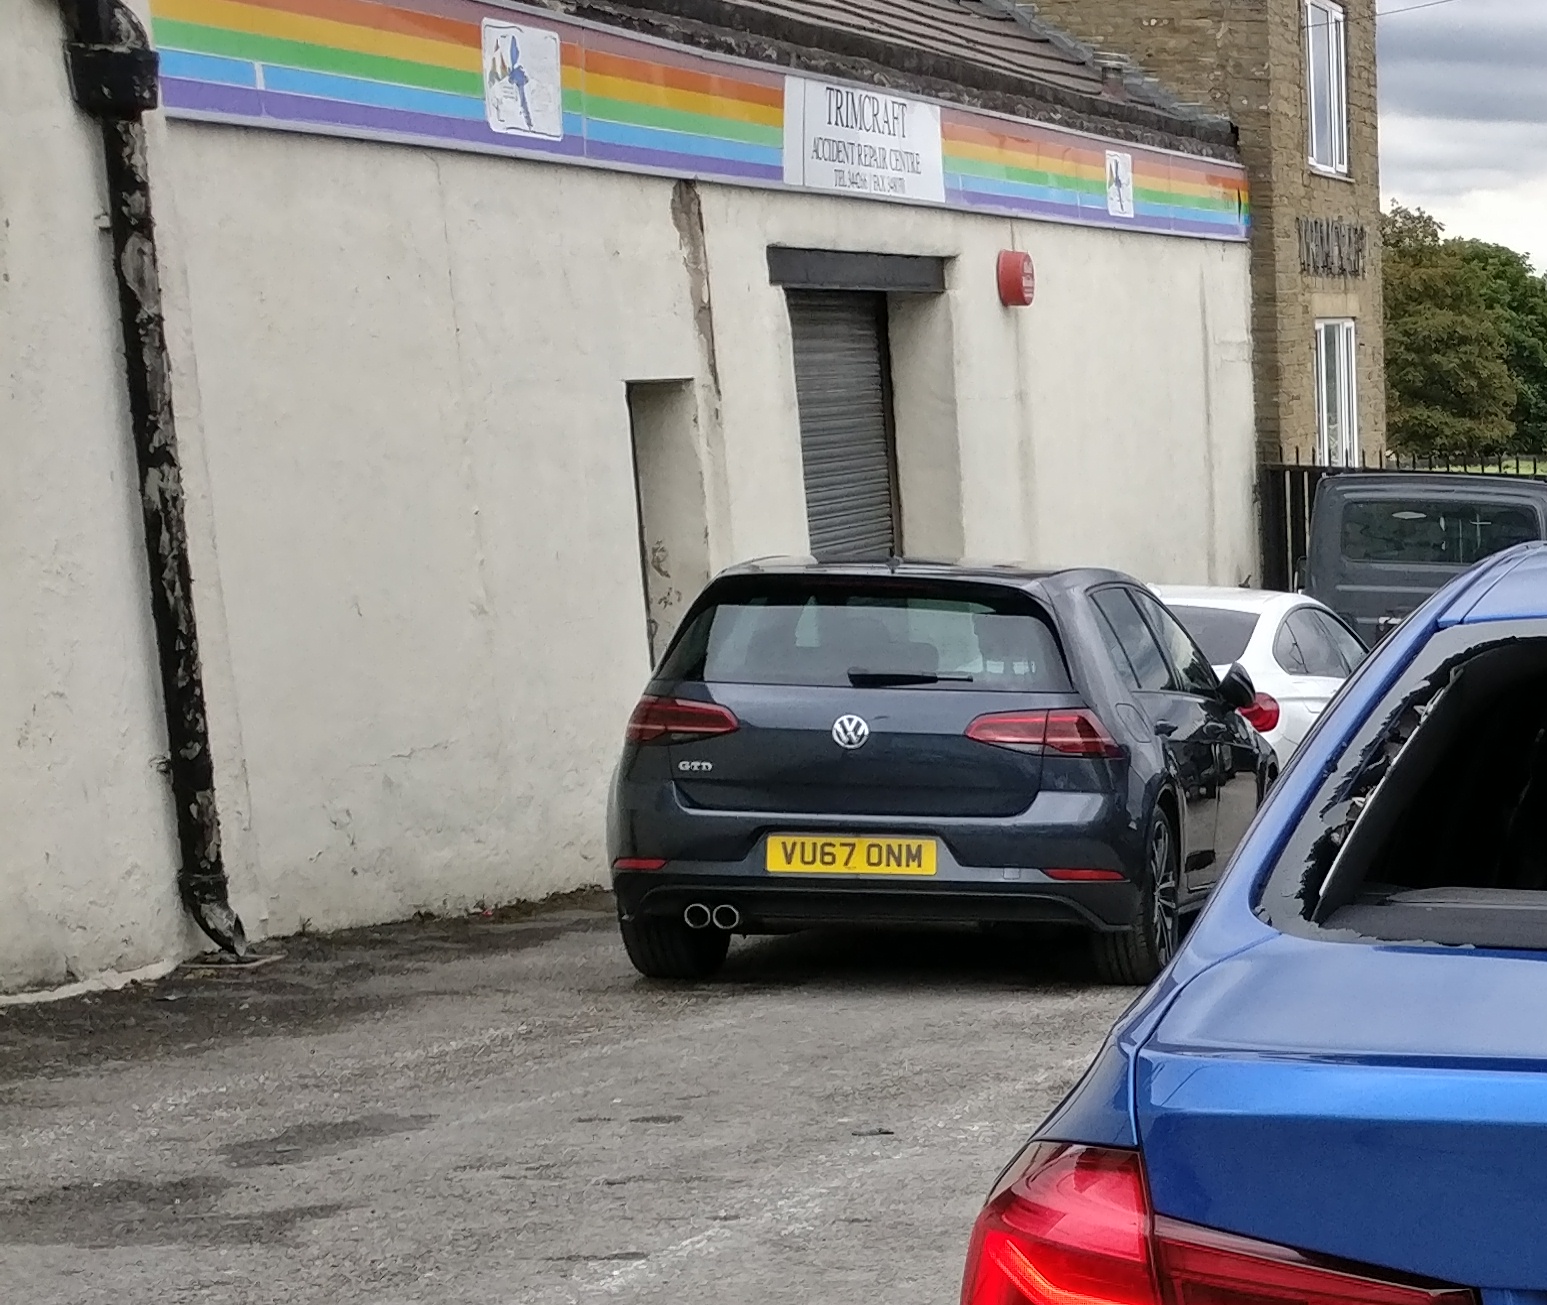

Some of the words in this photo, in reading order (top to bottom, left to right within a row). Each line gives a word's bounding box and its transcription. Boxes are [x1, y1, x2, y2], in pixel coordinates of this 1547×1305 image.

[825, 87, 908, 138] TRIMCRAFT
[811, 137, 855, 165] ACCIDENT
[857, 144, 888, 170] REPAIR
[889, 148, 922, 175] CENTRE
[678, 760, 713, 772] GTD
[781, 841, 856, 868] VU67
[866, 843, 922, 869] ONM
